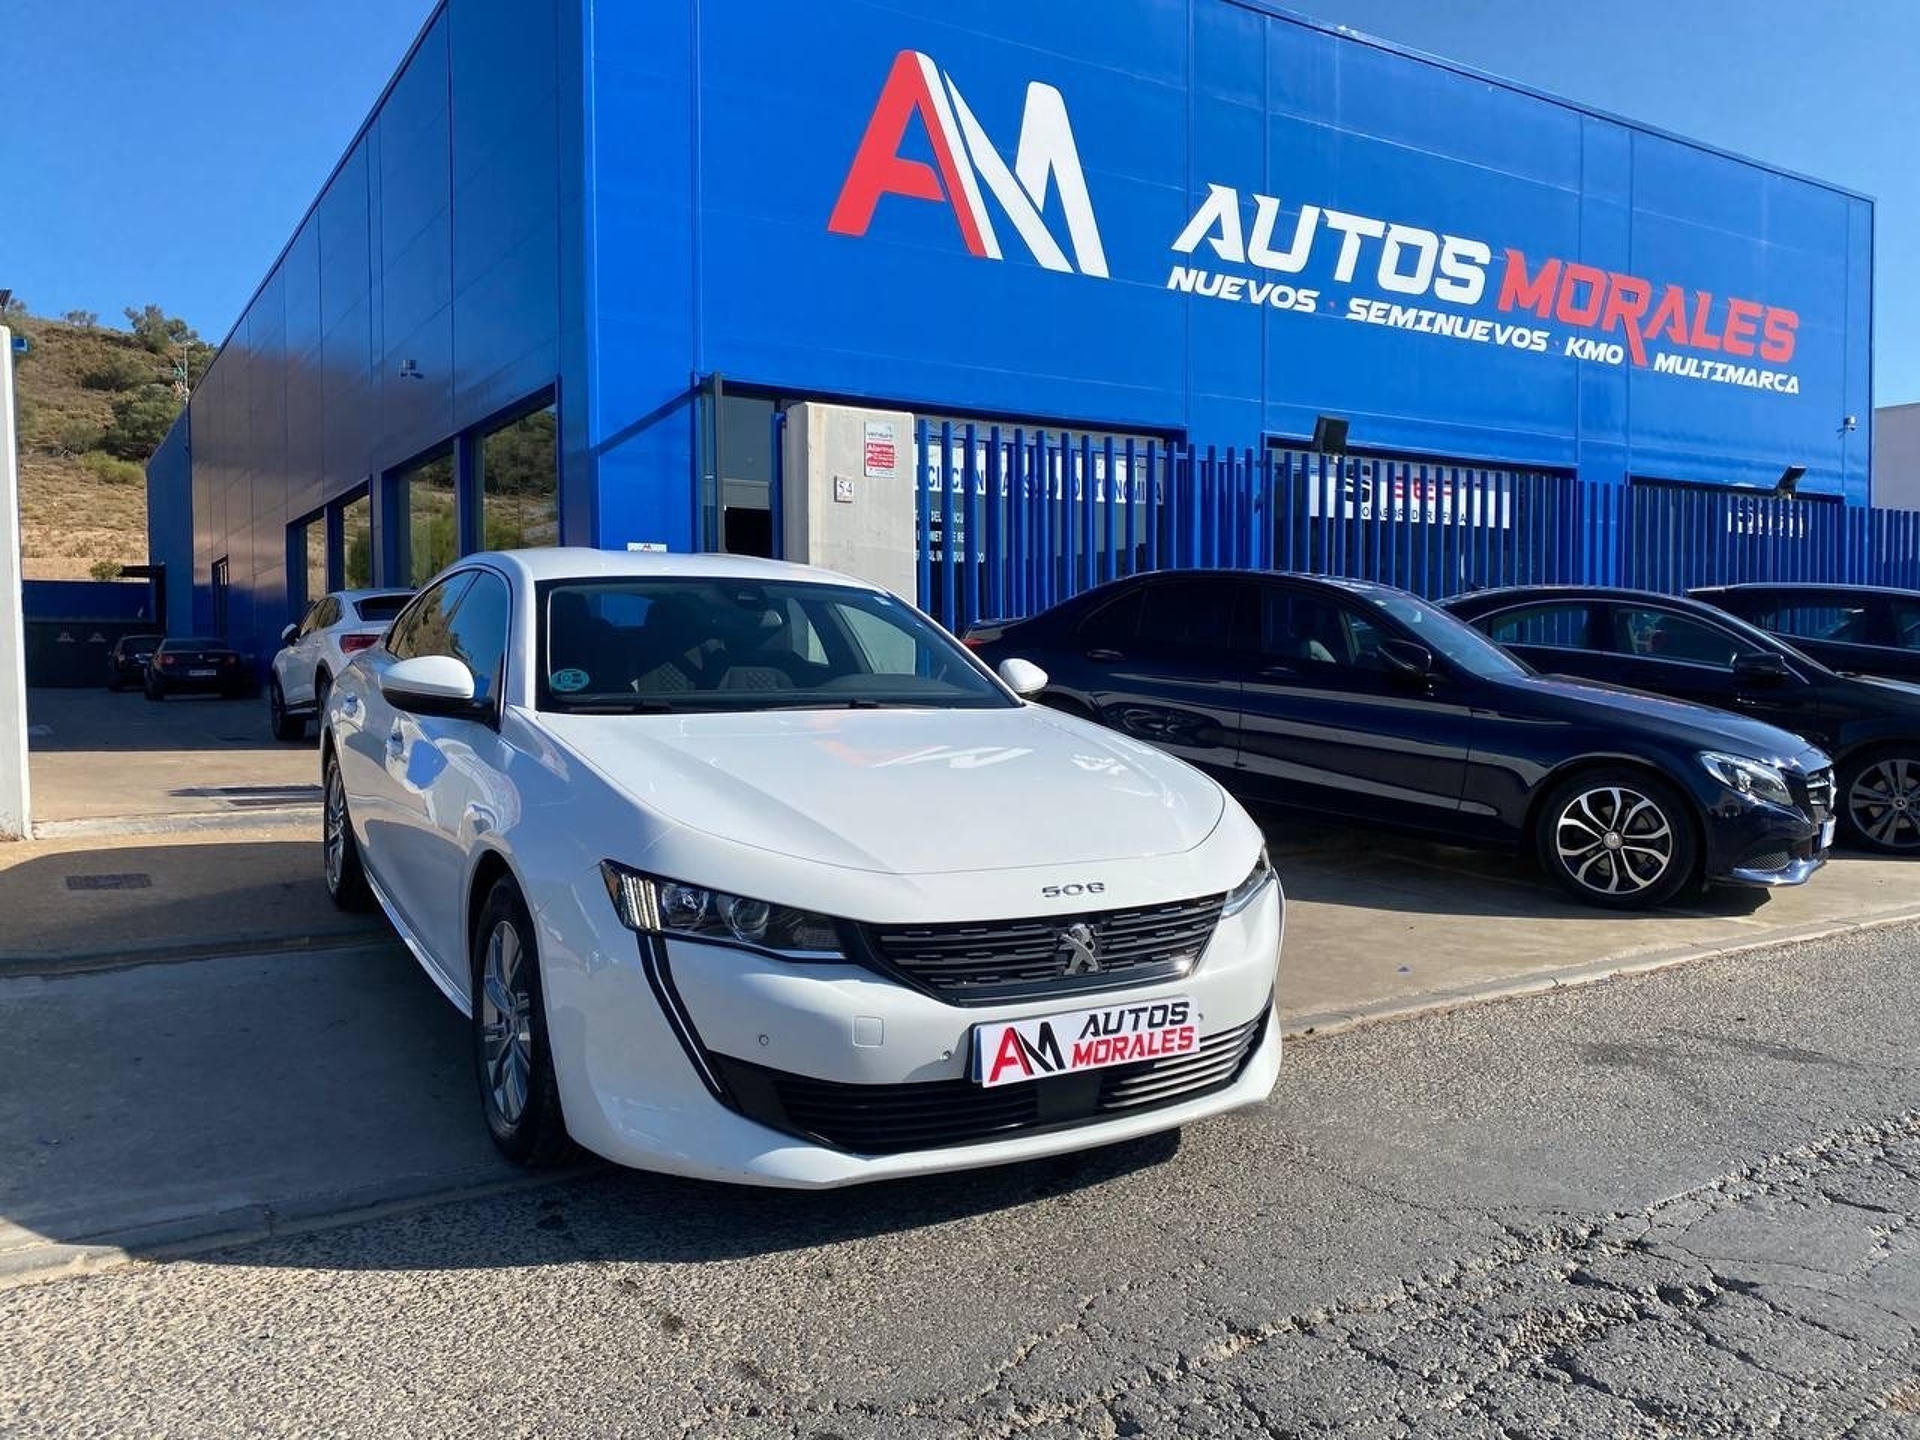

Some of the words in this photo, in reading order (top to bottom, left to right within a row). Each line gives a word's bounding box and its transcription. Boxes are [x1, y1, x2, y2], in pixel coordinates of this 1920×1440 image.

[828, 49, 1109, 278] AM
[1171, 182, 1491, 305] AUTOS
[1497, 248, 1799, 367] MORALES
[1166, 266, 1320, 313] NUEVOS
[1345, 297, 1550, 352] SEMINUEVOS
[1654, 353, 1799, 394] MULTIMARCA
[988, 1021, 1066, 1083] AM
[1072, 1026, 1194, 1068] MORALES
[1079, 1002, 1189, 1040] AUTOS
